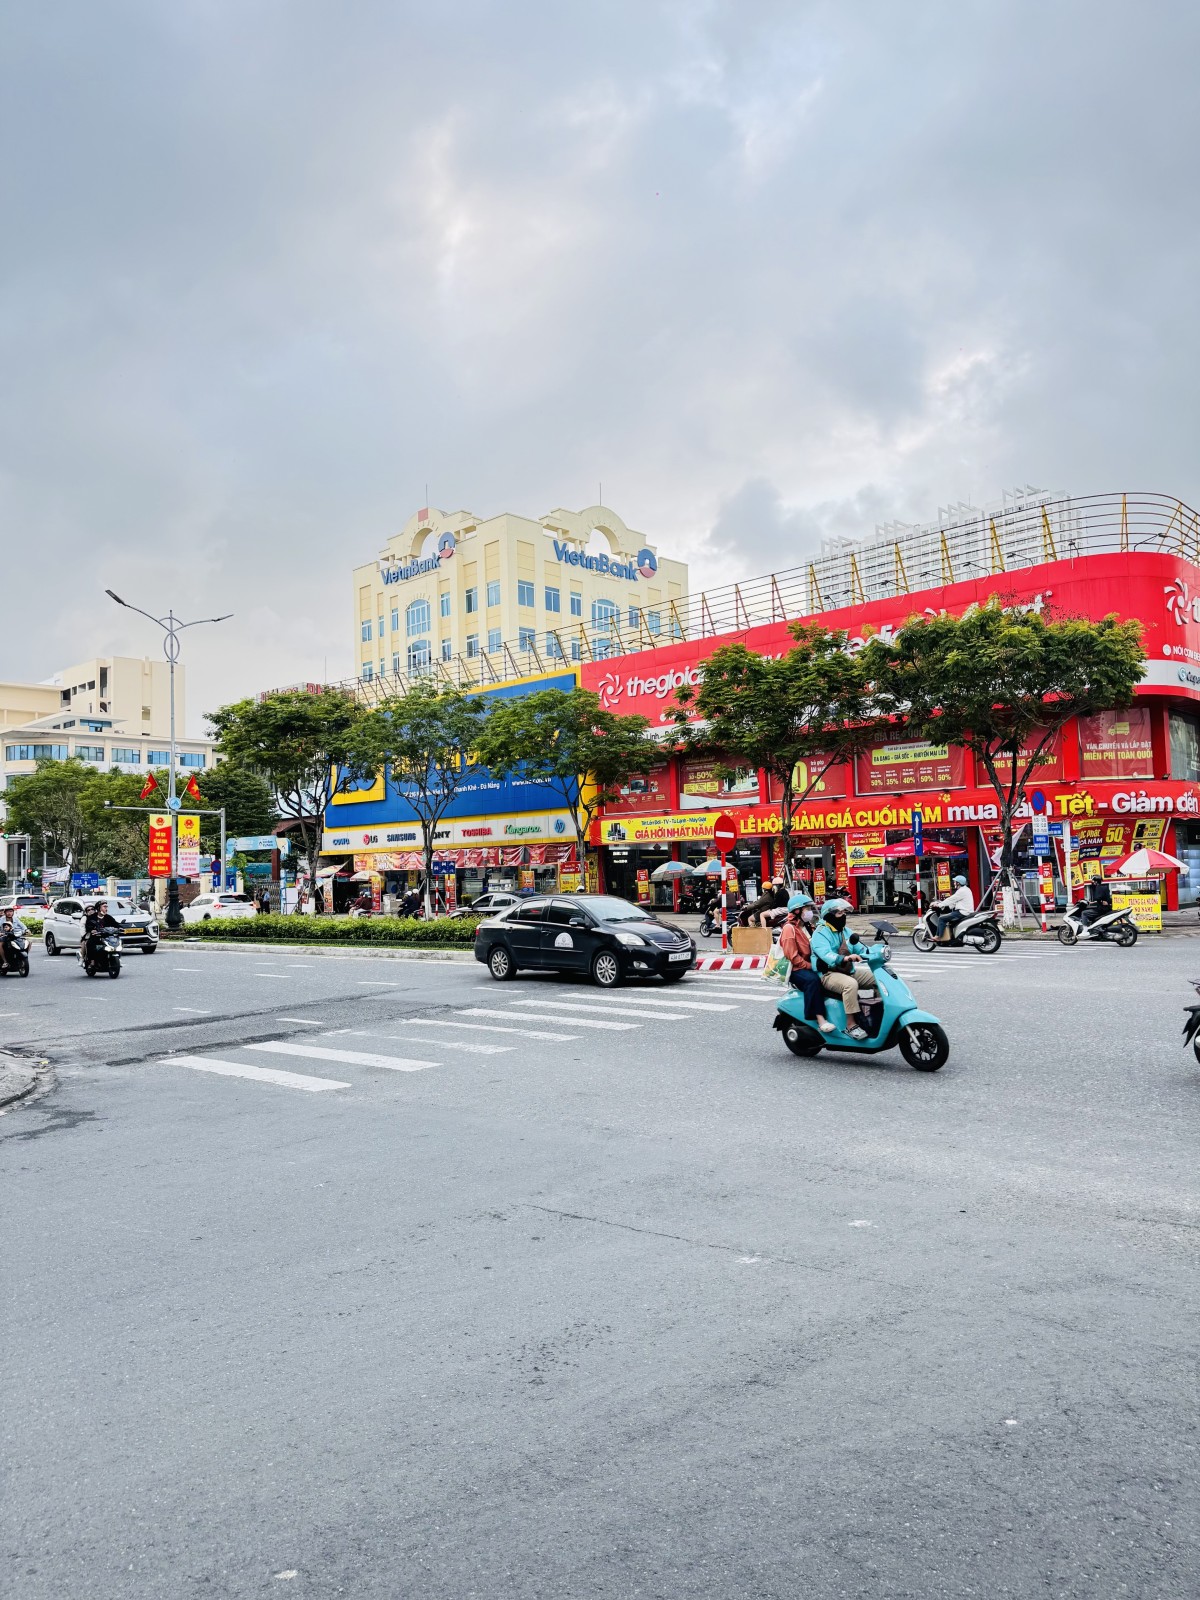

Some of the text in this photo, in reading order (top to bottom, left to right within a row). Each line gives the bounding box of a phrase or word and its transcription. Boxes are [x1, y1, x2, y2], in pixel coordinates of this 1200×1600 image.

[553, 540, 638, 581] VietinBank
[381, 552, 441, 585] VietinBank
[740, 815, 756, 834] LỄ
[826, 807, 854, 829] GIÁ
[856, 804, 897, 827] CUỐI
[947, 804, 997, 822] mua
[1055, 791, 1094, 815] Tết
[1112, 791, 1173, 813] Giảm
[370, 835, 378, 843] LG
[386, 833, 416, 842] SAMSUNG
[461, 827, 492, 838] TOSHIBA
[635, 824, 713, 839] GIÁ HỜI NHẤT NĂM
[1105, 827, 1124, 843] 50
